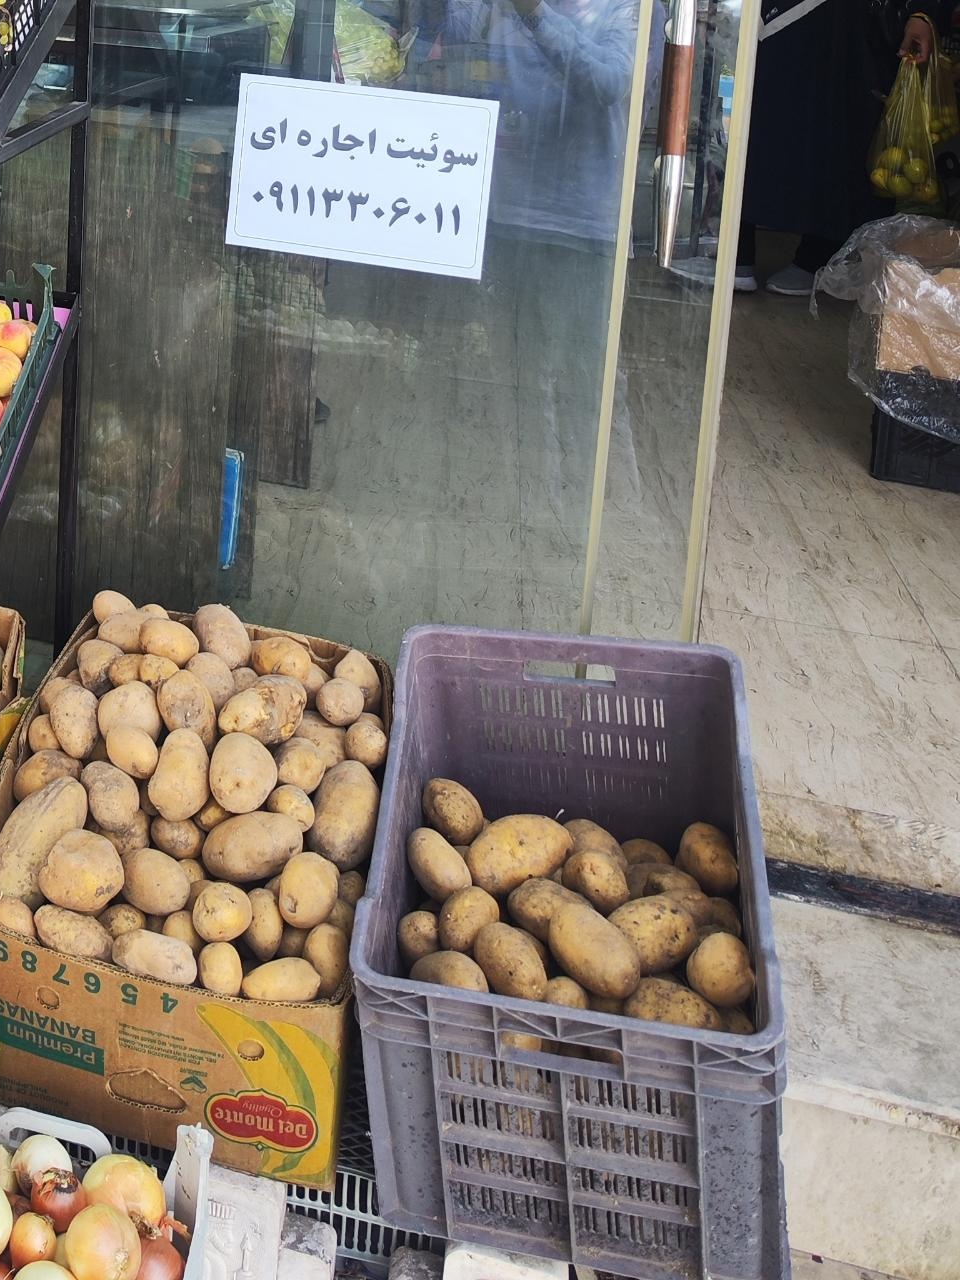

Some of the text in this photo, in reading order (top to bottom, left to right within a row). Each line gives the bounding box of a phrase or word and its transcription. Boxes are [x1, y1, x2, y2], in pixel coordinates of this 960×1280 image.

[250, 117, 478, 174] سوئیت اجاره ای
[252, 180, 461, 236] ۰۹۱۱۳۳۰۶۰۱۱
[20, 950, 38, 973] 8
[52, 963, 70, 986] 7
[83, 971, 101, 994] 6
[120, 982, 139, 1006] 5
[160, 991, 179, 1014] 4
[7, 1023, 96, 1065] Premium
[242, 1101, 283, 1118] Quality
[215, 1107, 308, 1139] Del Monte
